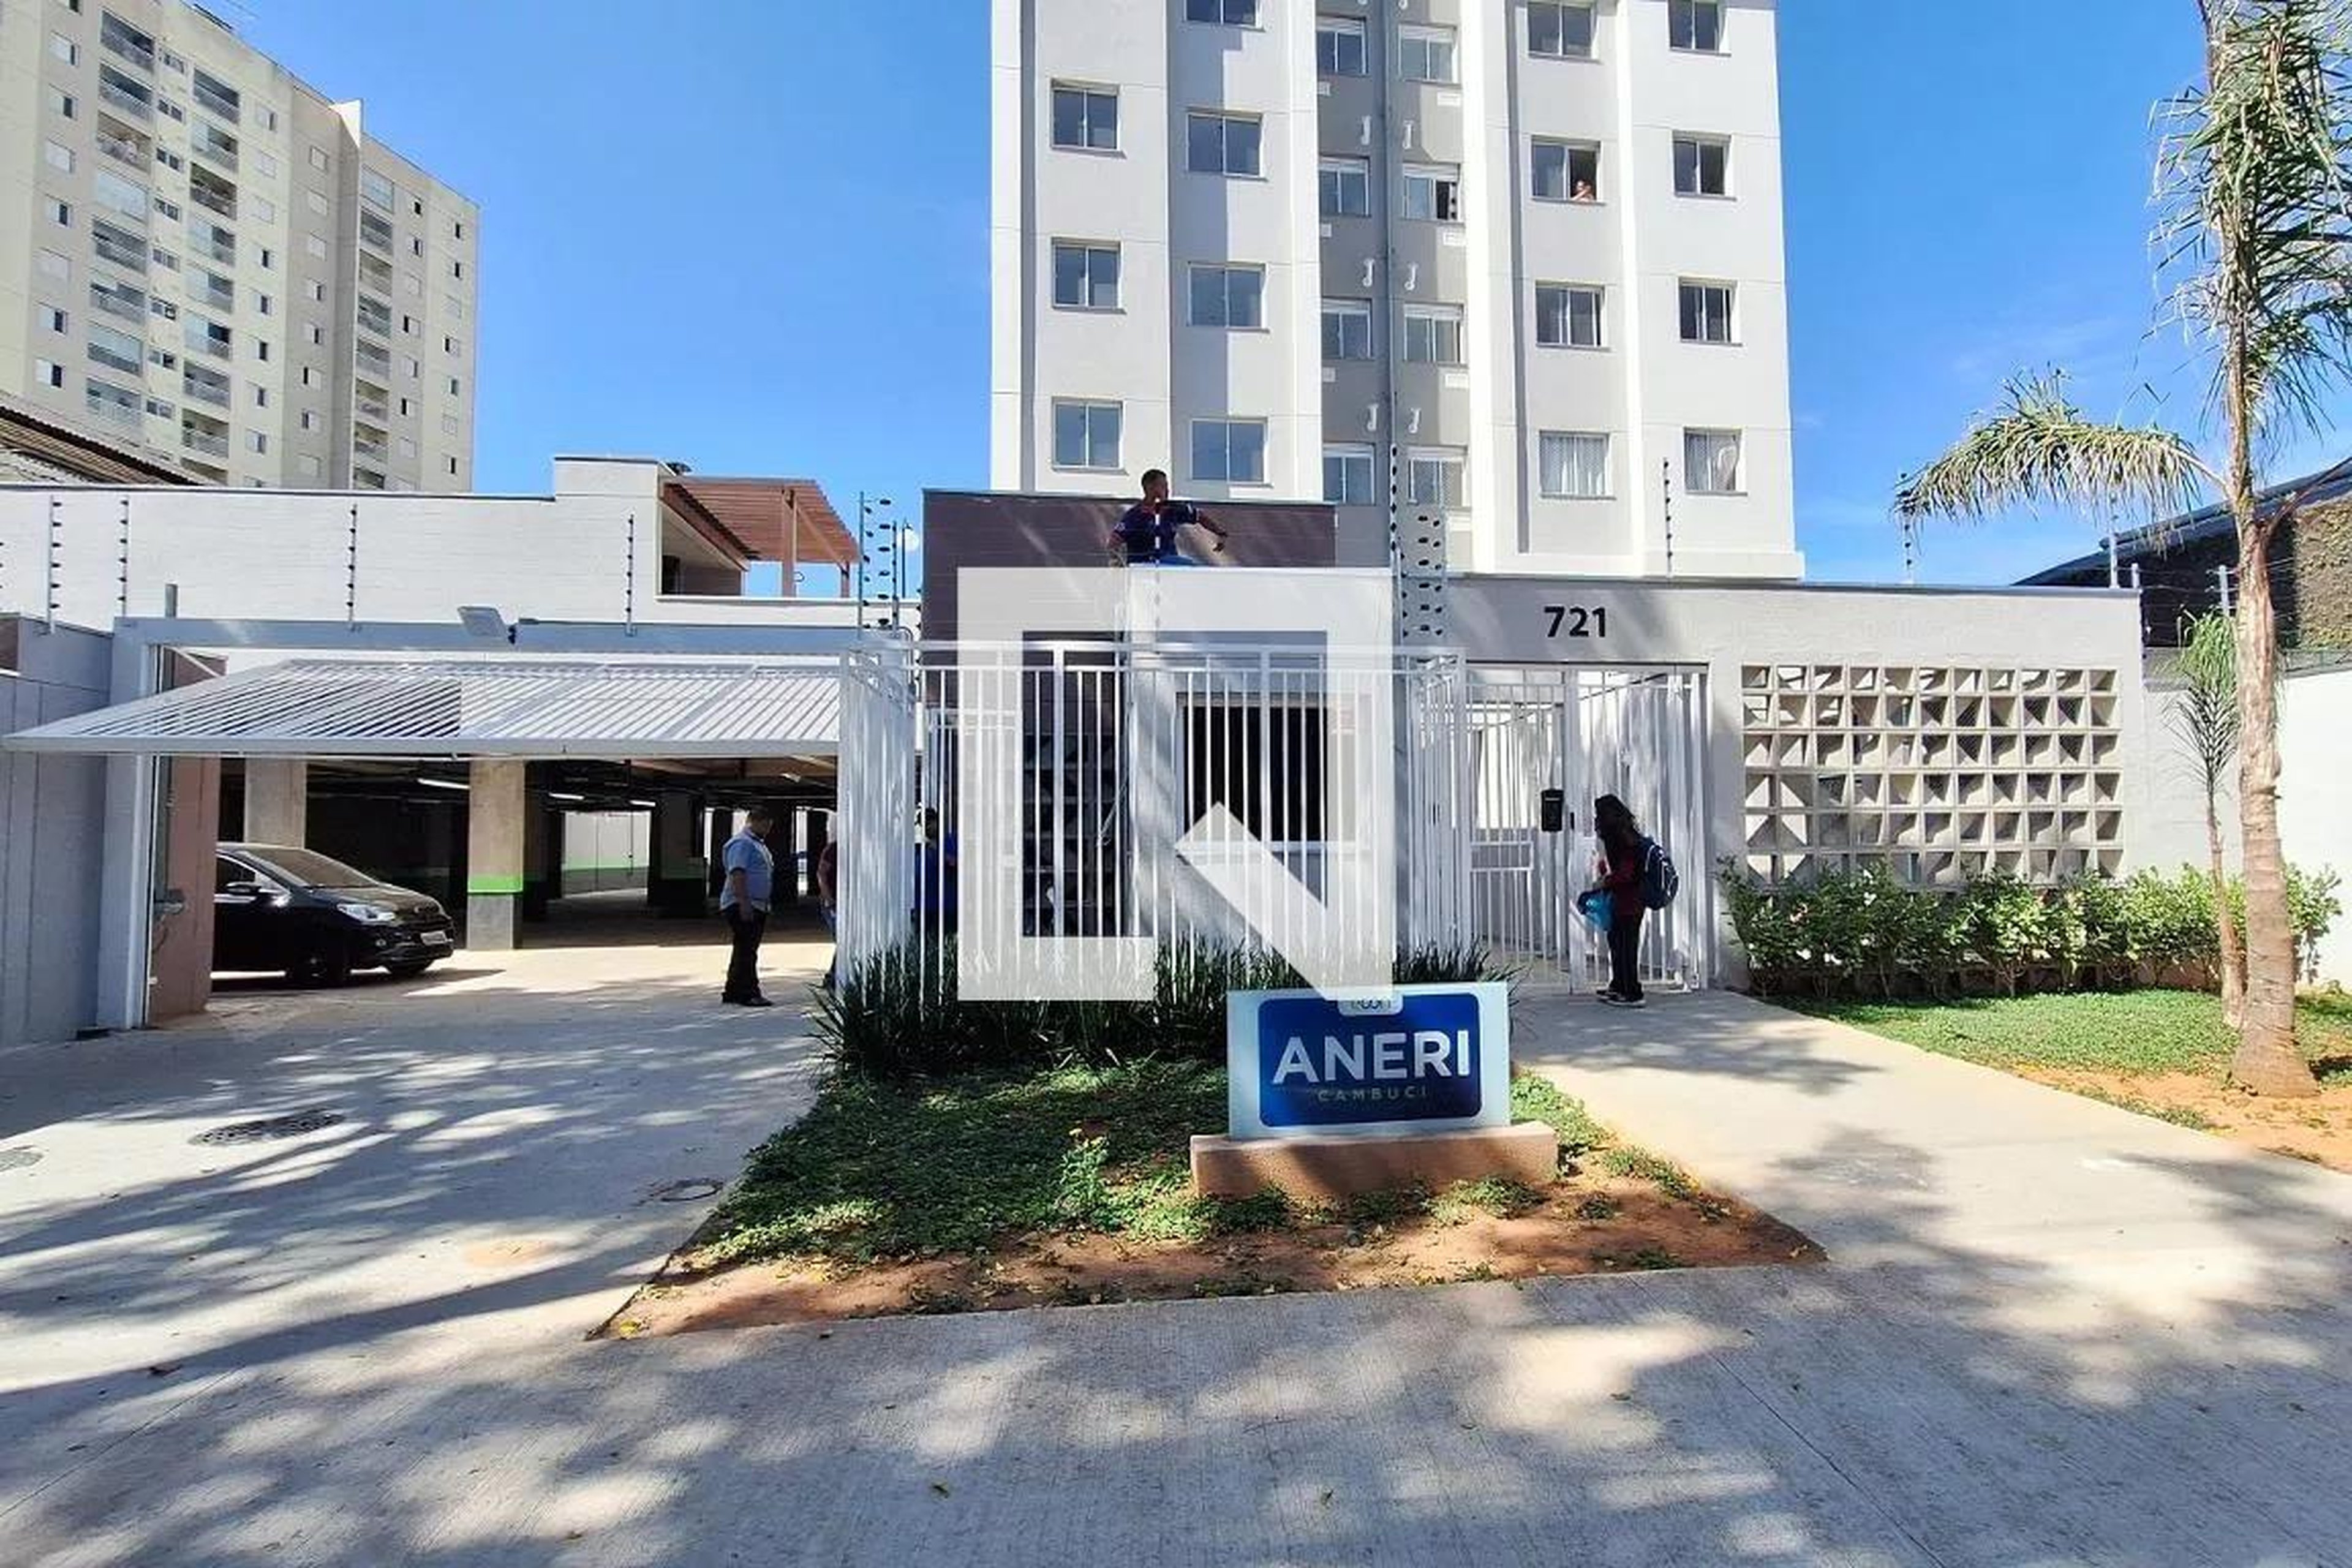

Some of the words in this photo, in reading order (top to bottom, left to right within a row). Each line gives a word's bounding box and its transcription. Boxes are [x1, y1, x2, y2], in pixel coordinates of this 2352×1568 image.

[1544, 606, 1605, 638] 721
[1273, 1030, 1469, 1084] ANERI
[1317, 1086, 1427, 1102] CAMBUCI
